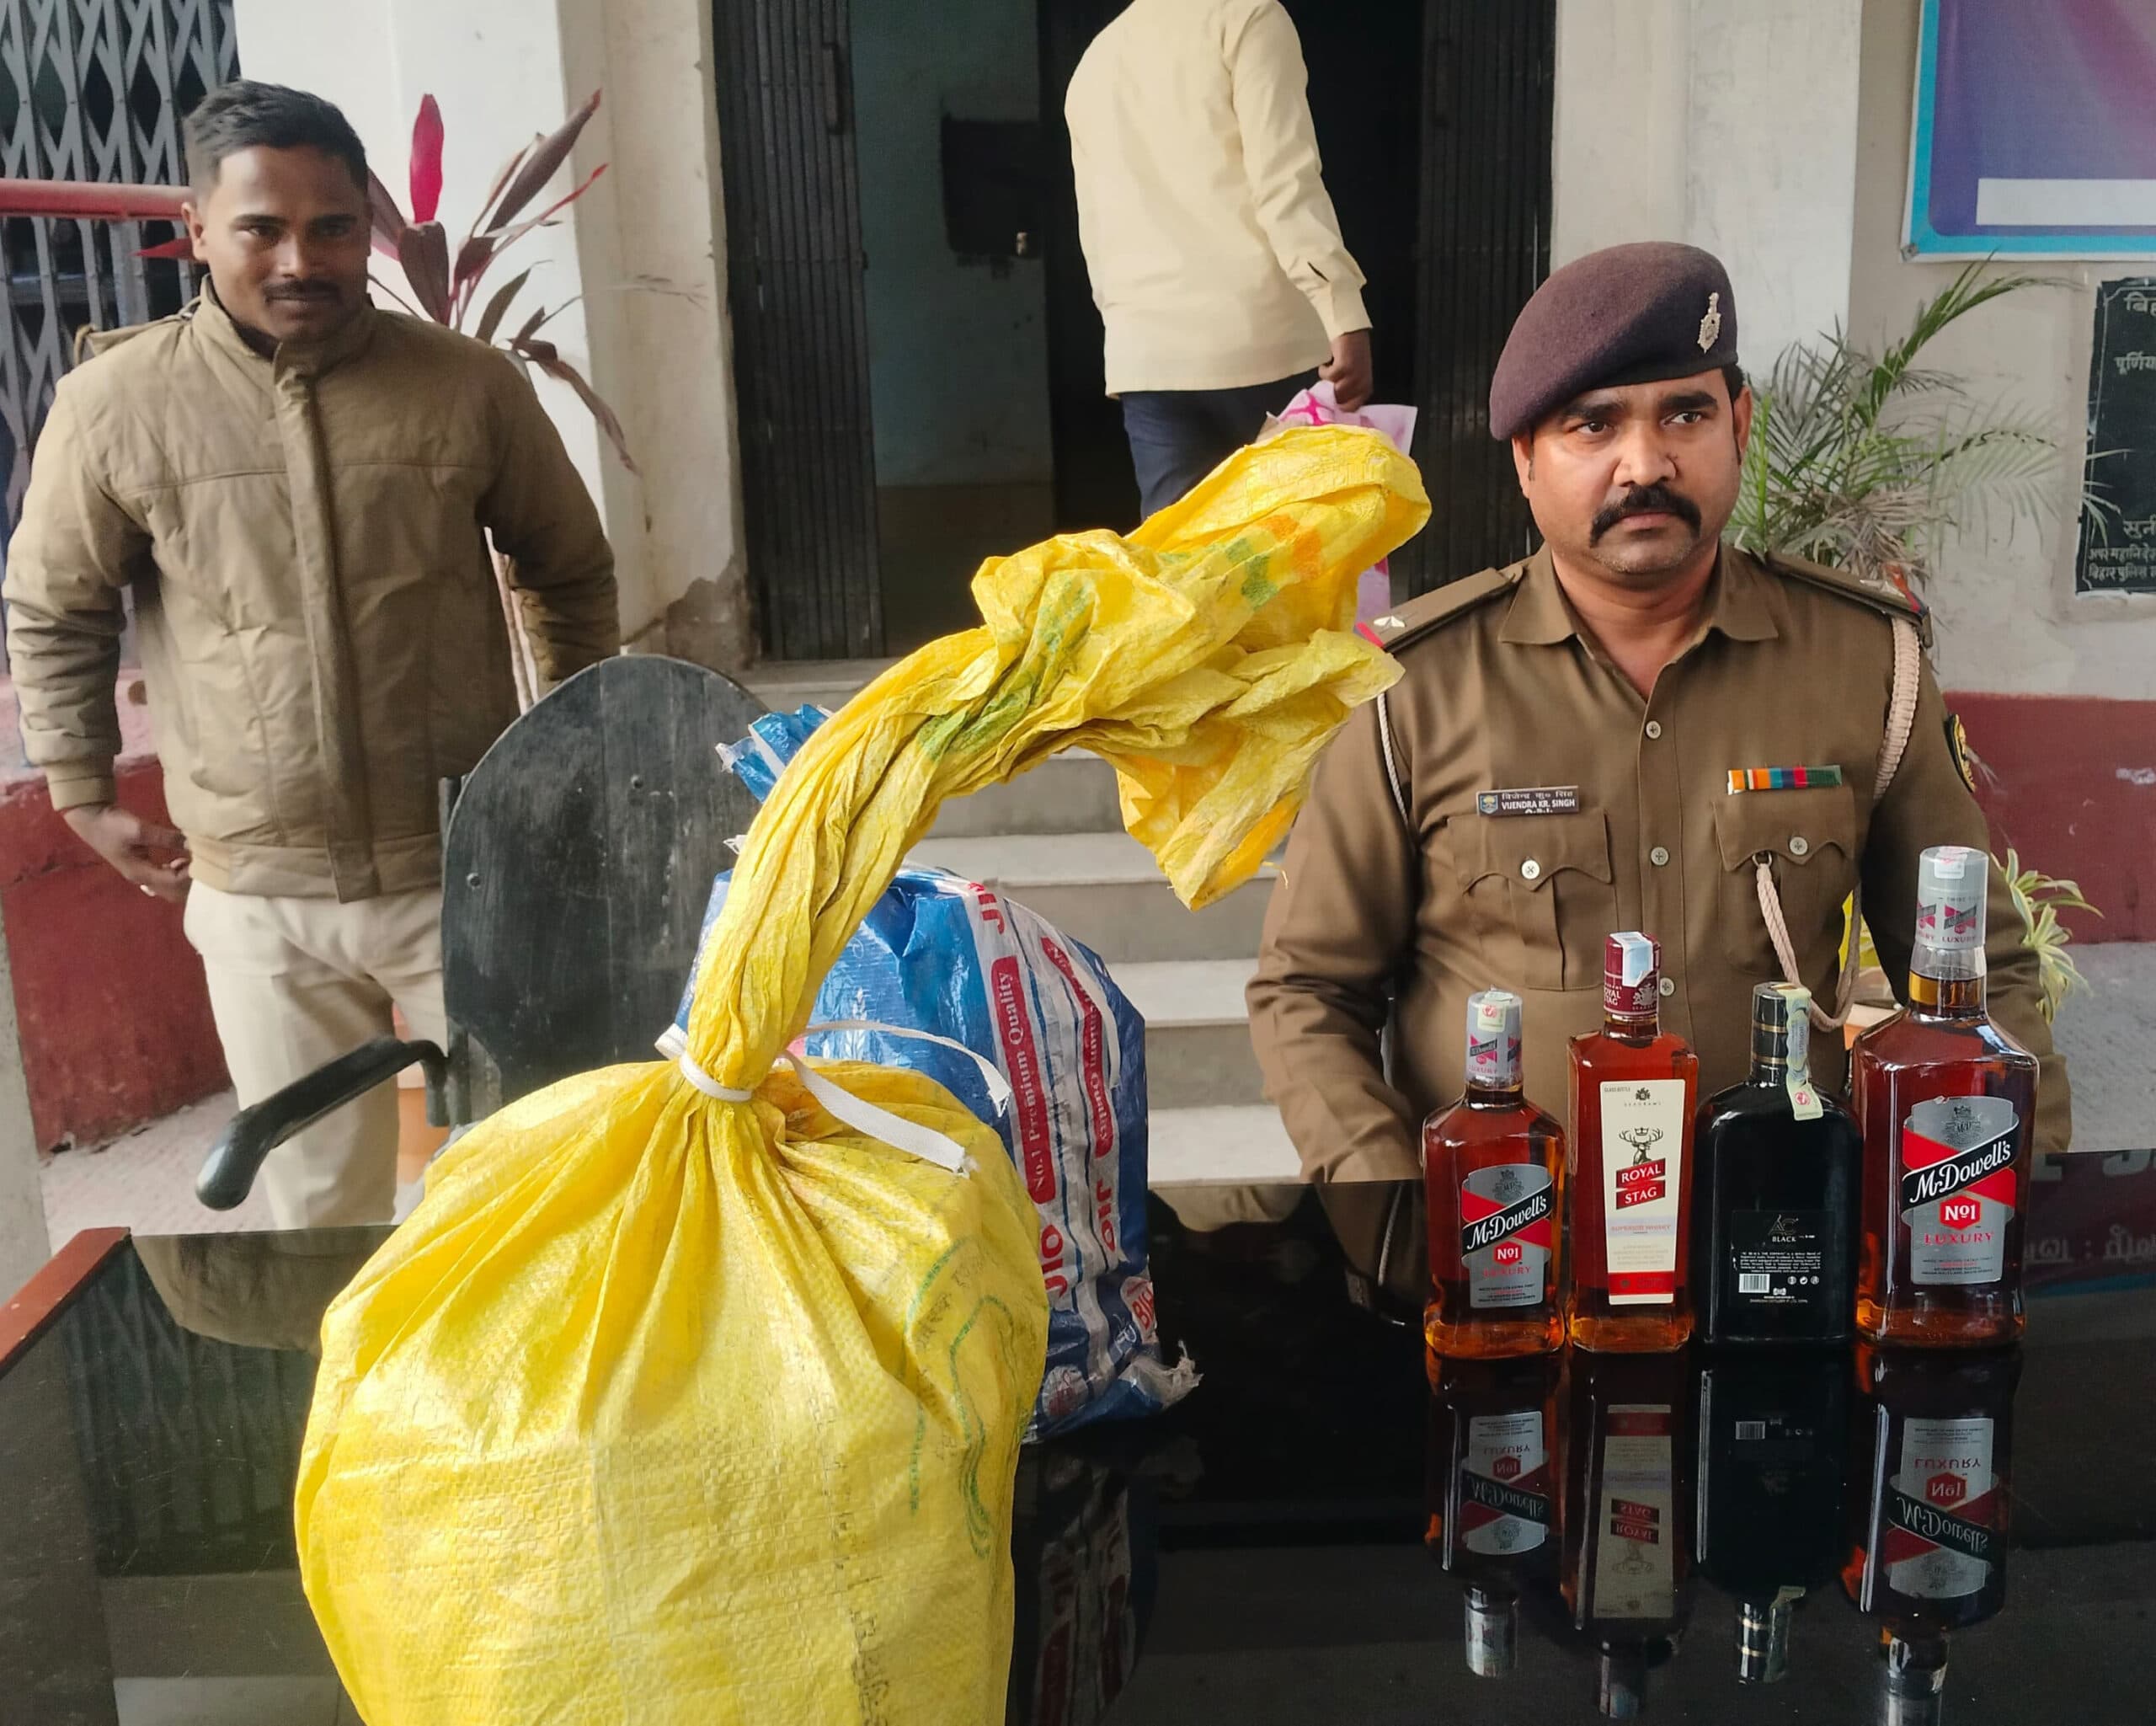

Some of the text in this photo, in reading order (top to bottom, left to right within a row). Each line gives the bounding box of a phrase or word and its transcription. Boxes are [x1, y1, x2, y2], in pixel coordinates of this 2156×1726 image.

[1502, 799, 1575, 810] VIJENDRA KR. SINGH
[998, 970, 1025, 1045] Quality
[1017, 1050, 1042, 1141] Premium
[1621, 1164, 1662, 1184] ROYAL
[1625, 1186, 1657, 1205] STAG
[1909, 1141, 2011, 1204] McDowell's
[1097, 1179, 1117, 1253] JIO
[1466, 1194, 1547, 1250] McDowell's
[1924, 1232, 1995, 1247] LUXURY
[1041, 1224, 1068, 1298] JIO
[1483, 1265, 1532, 1278] LUXURY
